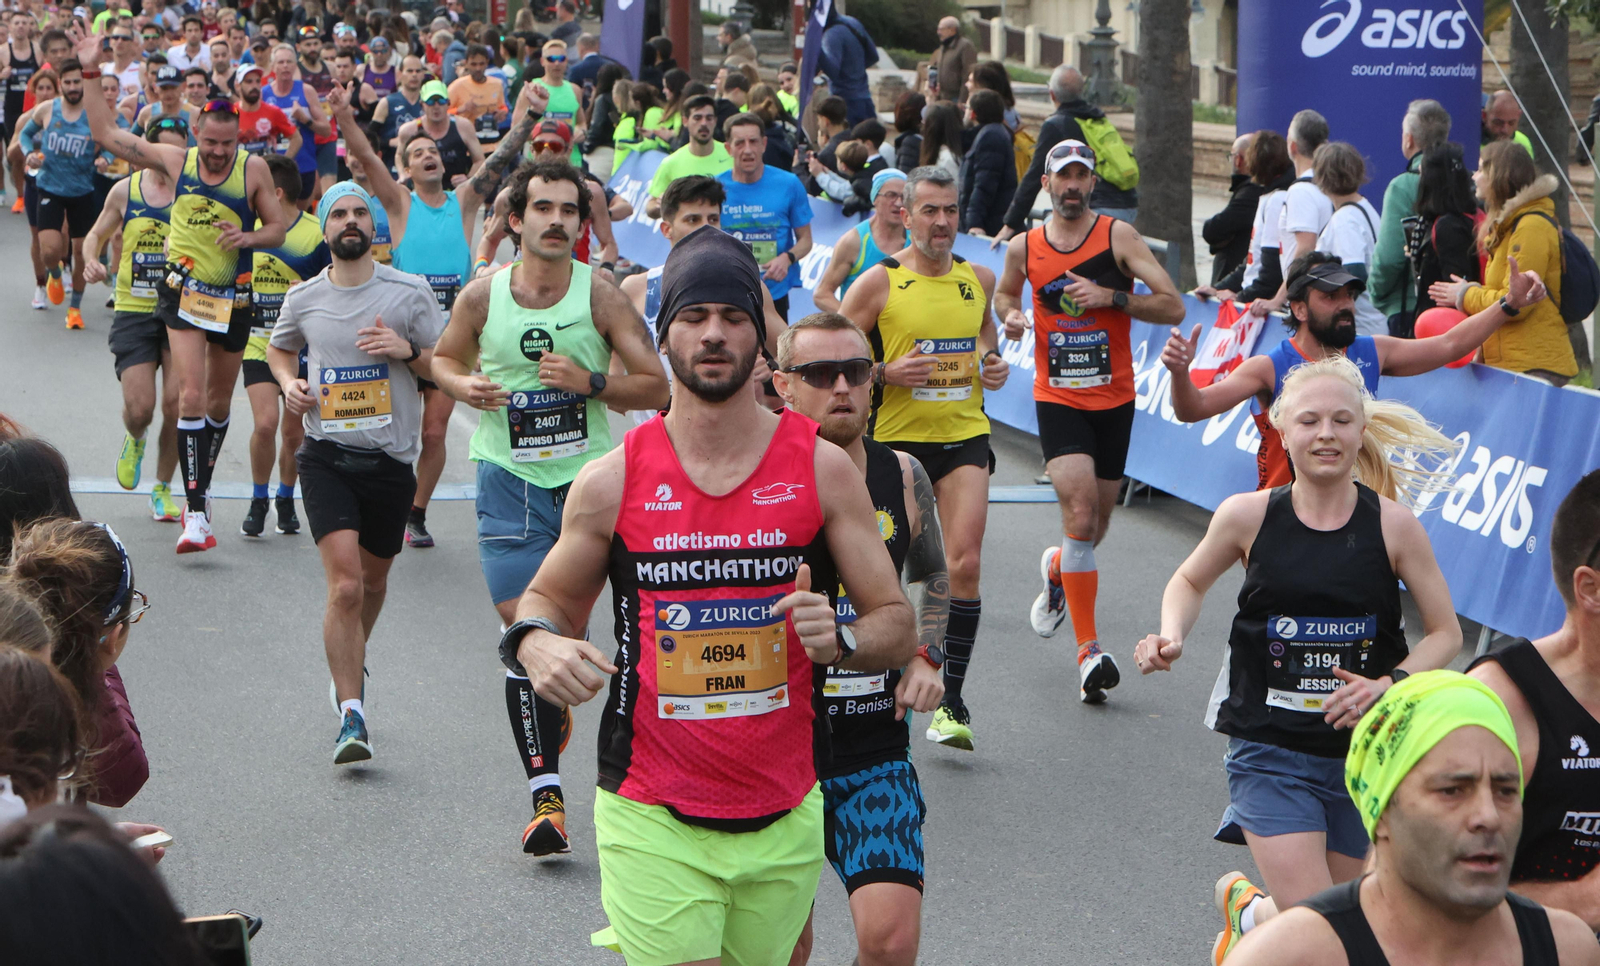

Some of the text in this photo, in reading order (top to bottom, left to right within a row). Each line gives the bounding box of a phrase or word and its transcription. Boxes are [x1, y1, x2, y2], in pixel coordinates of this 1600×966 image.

[1361, 9, 1467, 49] asics
[1351, 63, 1477, 79] sound mind, sound body
[743, 203, 763, 213] beau
[136, 240, 164, 248] BARAN
[147, 254, 165, 262] ZURI
[429, 276, 457, 284] ZURICH
[261, 294, 284, 302] ZURIC
[190, 308, 217, 320] EDUARDO
[1056, 316, 1096, 329] TORINO
[523, 339, 550, 348] NIGHT
[1068, 334, 1102, 344] ZURICH
[938, 341, 972, 350] ZURICH
[1068, 353, 1090, 364] 3324
[937, 361, 959, 372] 5245
[340, 368, 380, 380] ZURICH
[926, 378, 947, 386] NOLO
[341, 390, 366, 402] 4424
[532, 391, 577, 404] ZURICH
[334, 406, 376, 418] ROMANITO
[534, 414, 561, 429] 2407
[518, 429, 583, 447] AFONSO MARIA
[752, 494, 797, 506] MANCHATHON
[1441, 445, 1549, 549] asics
[644, 501, 683, 511] VIATOR
[653, 528, 787, 550] atletismo club
[636, 555, 804, 585] MANCHATHON
[700, 604, 773, 623] ZURICH
[1305, 622, 1366, 636] ZURICH
[701, 643, 746, 663] 4694
[1303, 652, 1341, 668] 3194
[705, 675, 746, 691] FRAN
[1296, 677, 1347, 691] JESSICA
[845, 696, 894, 715] Benissa
[519, 688, 537, 756] COMPRESPORT
